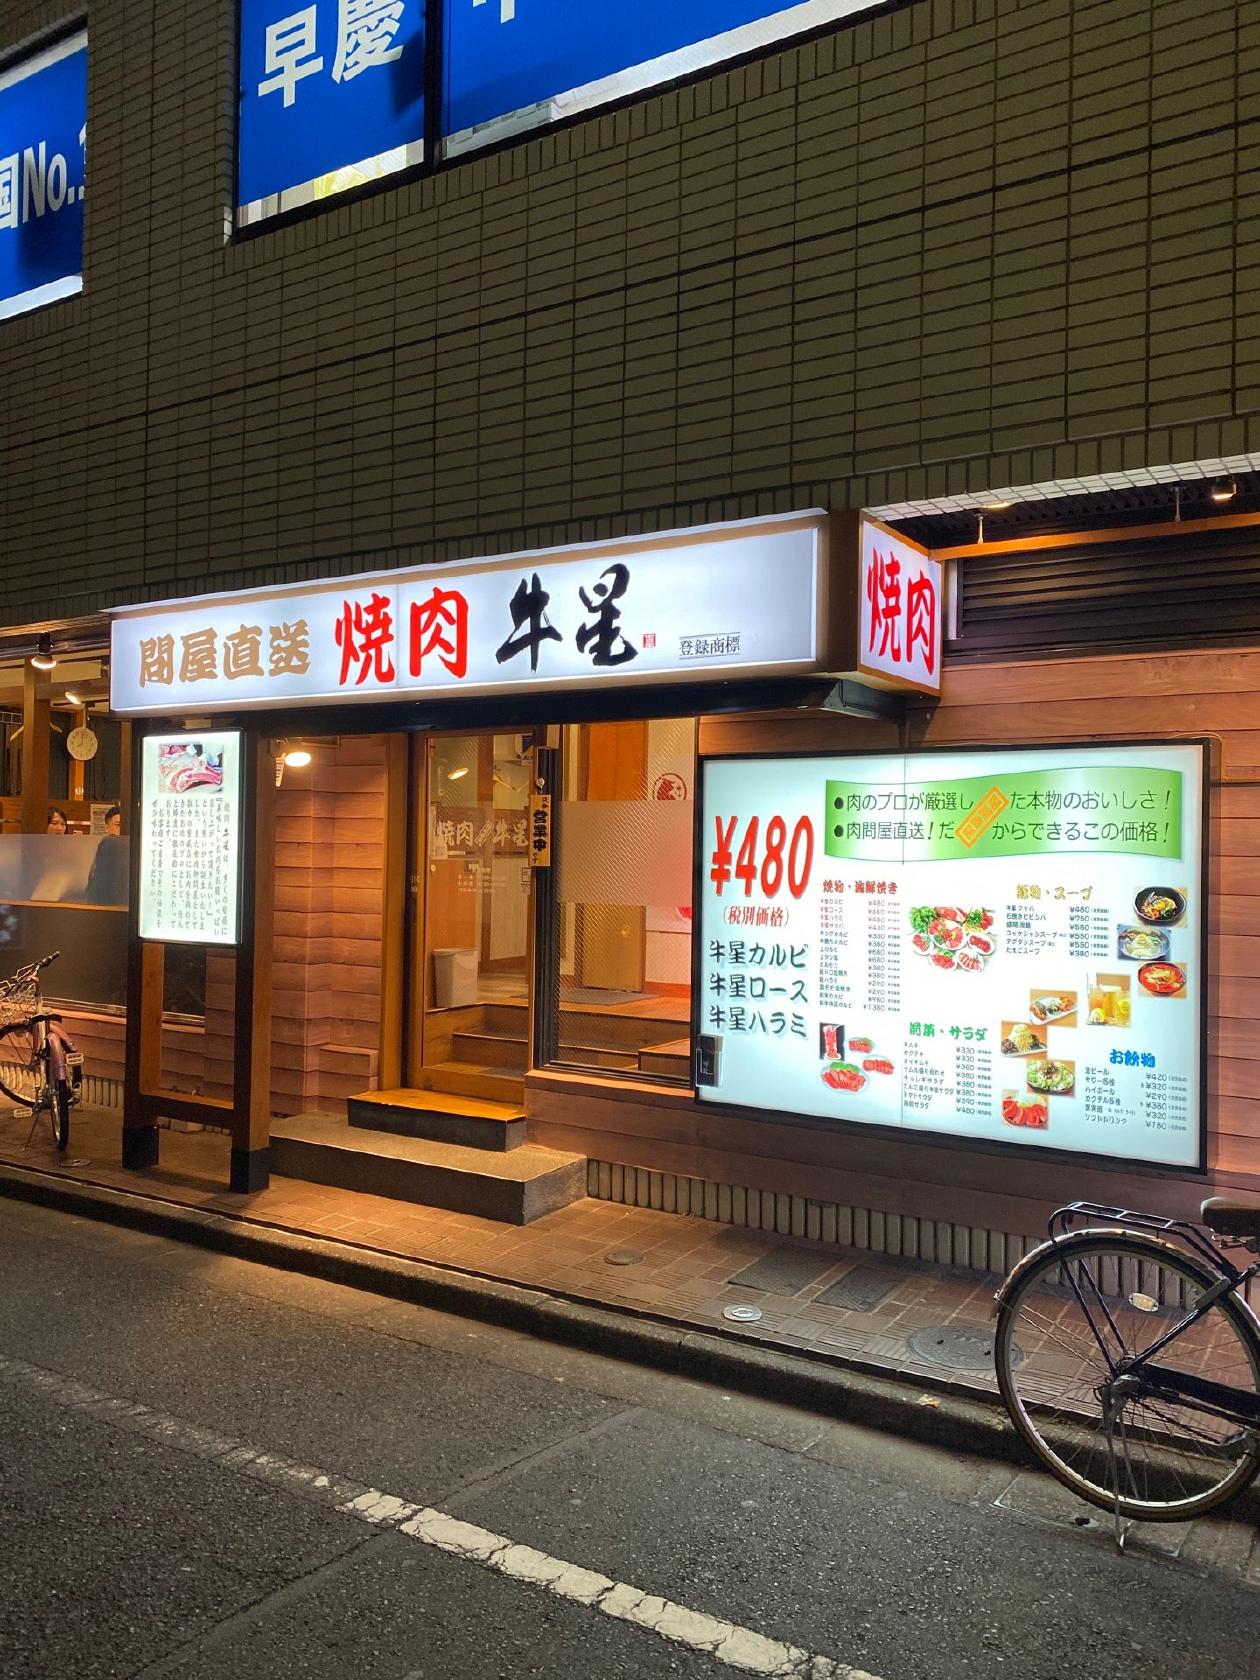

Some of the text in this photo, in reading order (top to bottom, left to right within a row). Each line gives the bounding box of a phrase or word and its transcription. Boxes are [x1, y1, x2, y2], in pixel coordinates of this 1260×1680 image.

[258, 0, 405, 108] 早慶
[139, 563, 741, 688] 問屋直送 焼肉 牛星 登録商標
[867, 547, 936, 675] 焼肉
[846, 793, 974, 811] 肉のプロが厳選し
[436, 820, 474, 847] 焼肉
[532, 809, 548, 852] 営業中
[992, 822, 1171, 844] からできるこの価格！
[710, 815, 815, 900] ¥480
[709, 939, 809, 969] 牛星カルビ
[709, 972, 808, 1003] 牛星ロース
[709, 1005, 807, 1039] 牛星ハラミ
